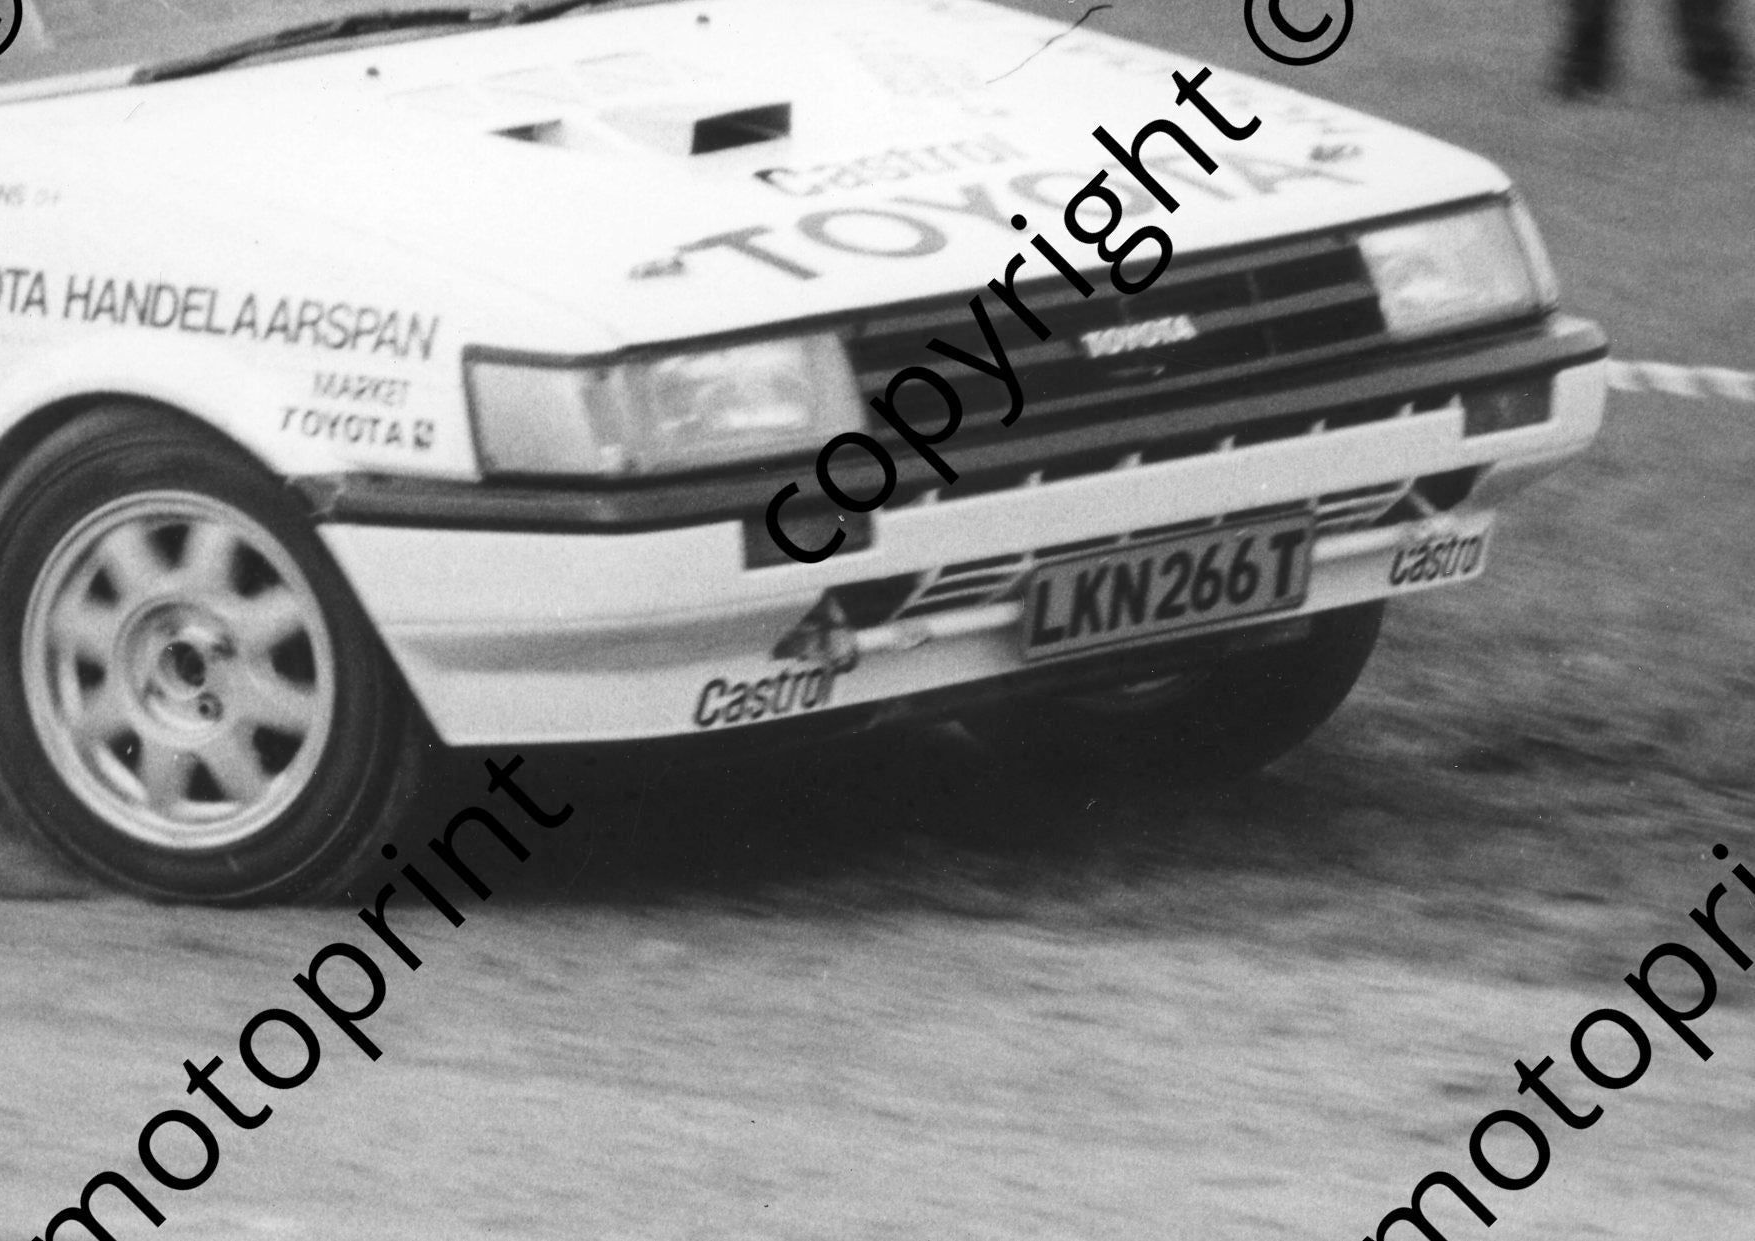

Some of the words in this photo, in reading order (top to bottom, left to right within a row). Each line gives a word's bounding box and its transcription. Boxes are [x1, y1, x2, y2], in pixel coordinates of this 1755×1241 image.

[676, 151, 1366, 280] TOYOTA
[64, 275, 440, 360] HANDELAARSPAN
[279, 406, 403, 446] TOYOTA
